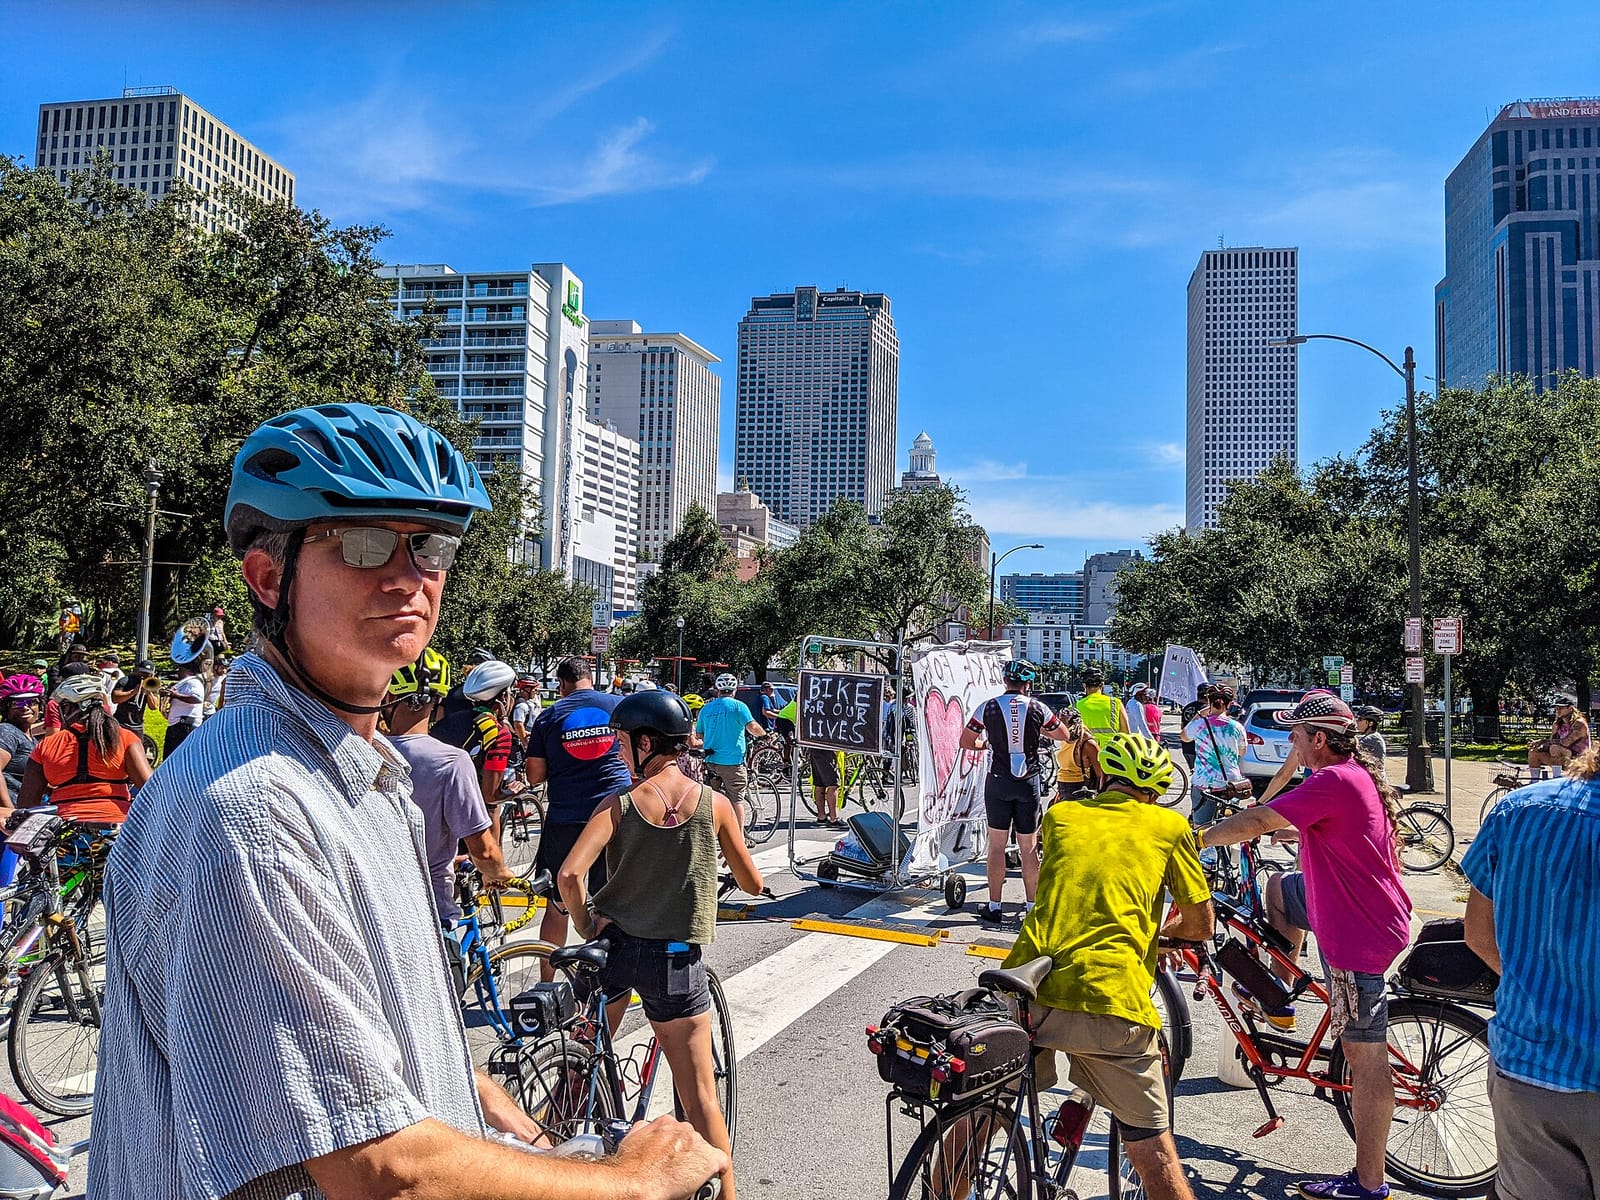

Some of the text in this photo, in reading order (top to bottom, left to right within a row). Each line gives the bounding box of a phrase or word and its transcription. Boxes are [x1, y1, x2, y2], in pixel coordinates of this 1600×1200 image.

[1547, 108, 1570, 117] AND
[809, 676, 873, 708] BIKE
[833, 702, 868, 726] OUR
[1009, 698, 1020, 744] WOLFIELD
[809, 717, 865, 744] LIVES
[1207, 987, 1242, 1033] ownie
